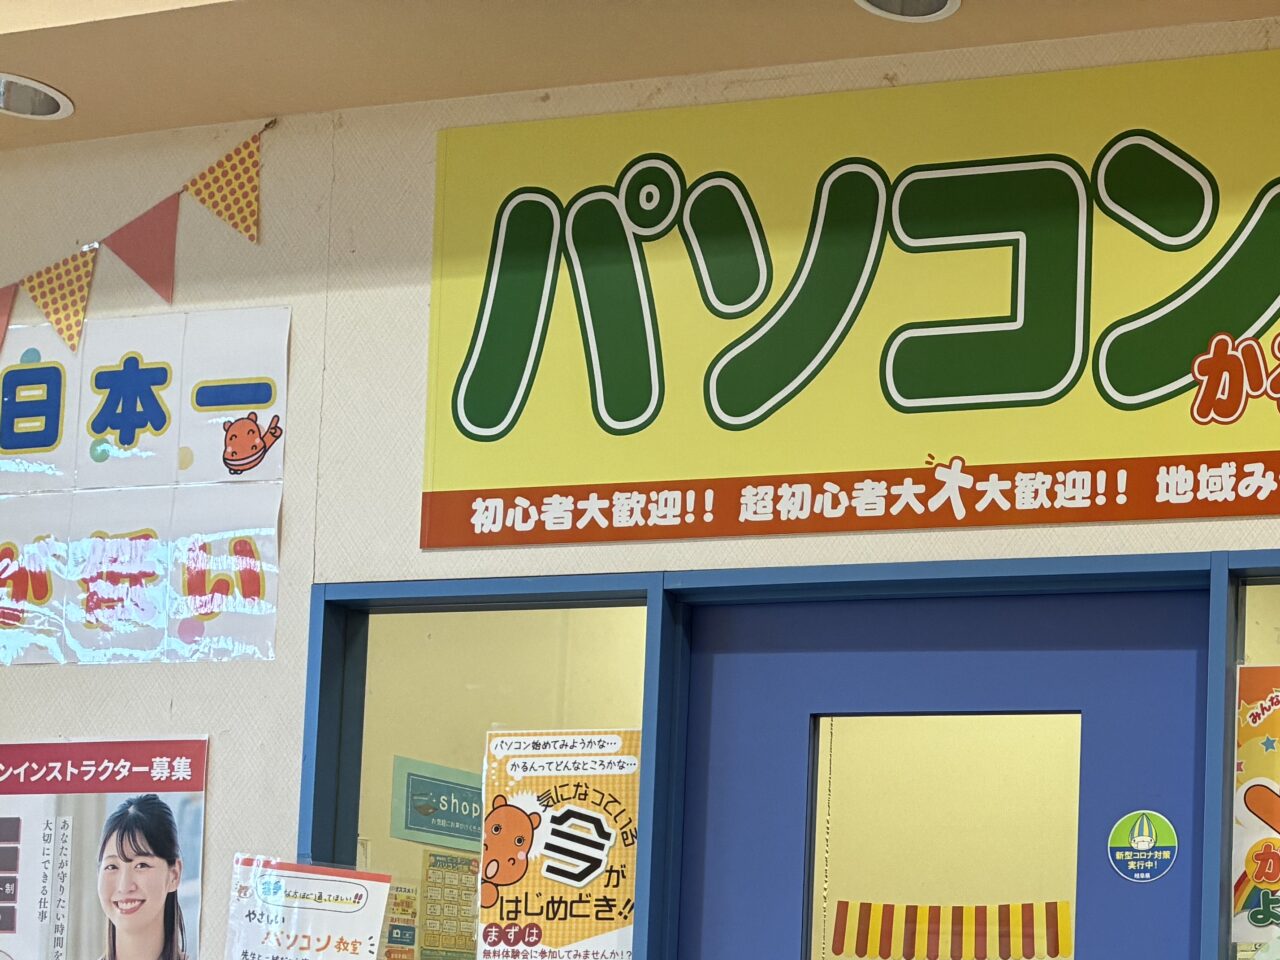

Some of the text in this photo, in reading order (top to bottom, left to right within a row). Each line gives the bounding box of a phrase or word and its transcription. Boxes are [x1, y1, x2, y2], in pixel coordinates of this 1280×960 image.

[0, 352, 275, 452] 日本一
[471, 490, 715, 535] 初心者大歓迎!!
[0, 756, 192, 782] ンインストラクター募集
[439, 793, 480, 818] shop
[1115, 850, 1171, 860] 新型コロナ対策
[1127, 860, 1158, 870] 実行中!
[38, 819, 53, 923] 大切にできる仕事
[604, 864, 626, 888] が
[245, 909, 285, 924] やさしい
[500, 892, 635, 922] はじめどき!!
[485, 926, 540, 944] まずは
